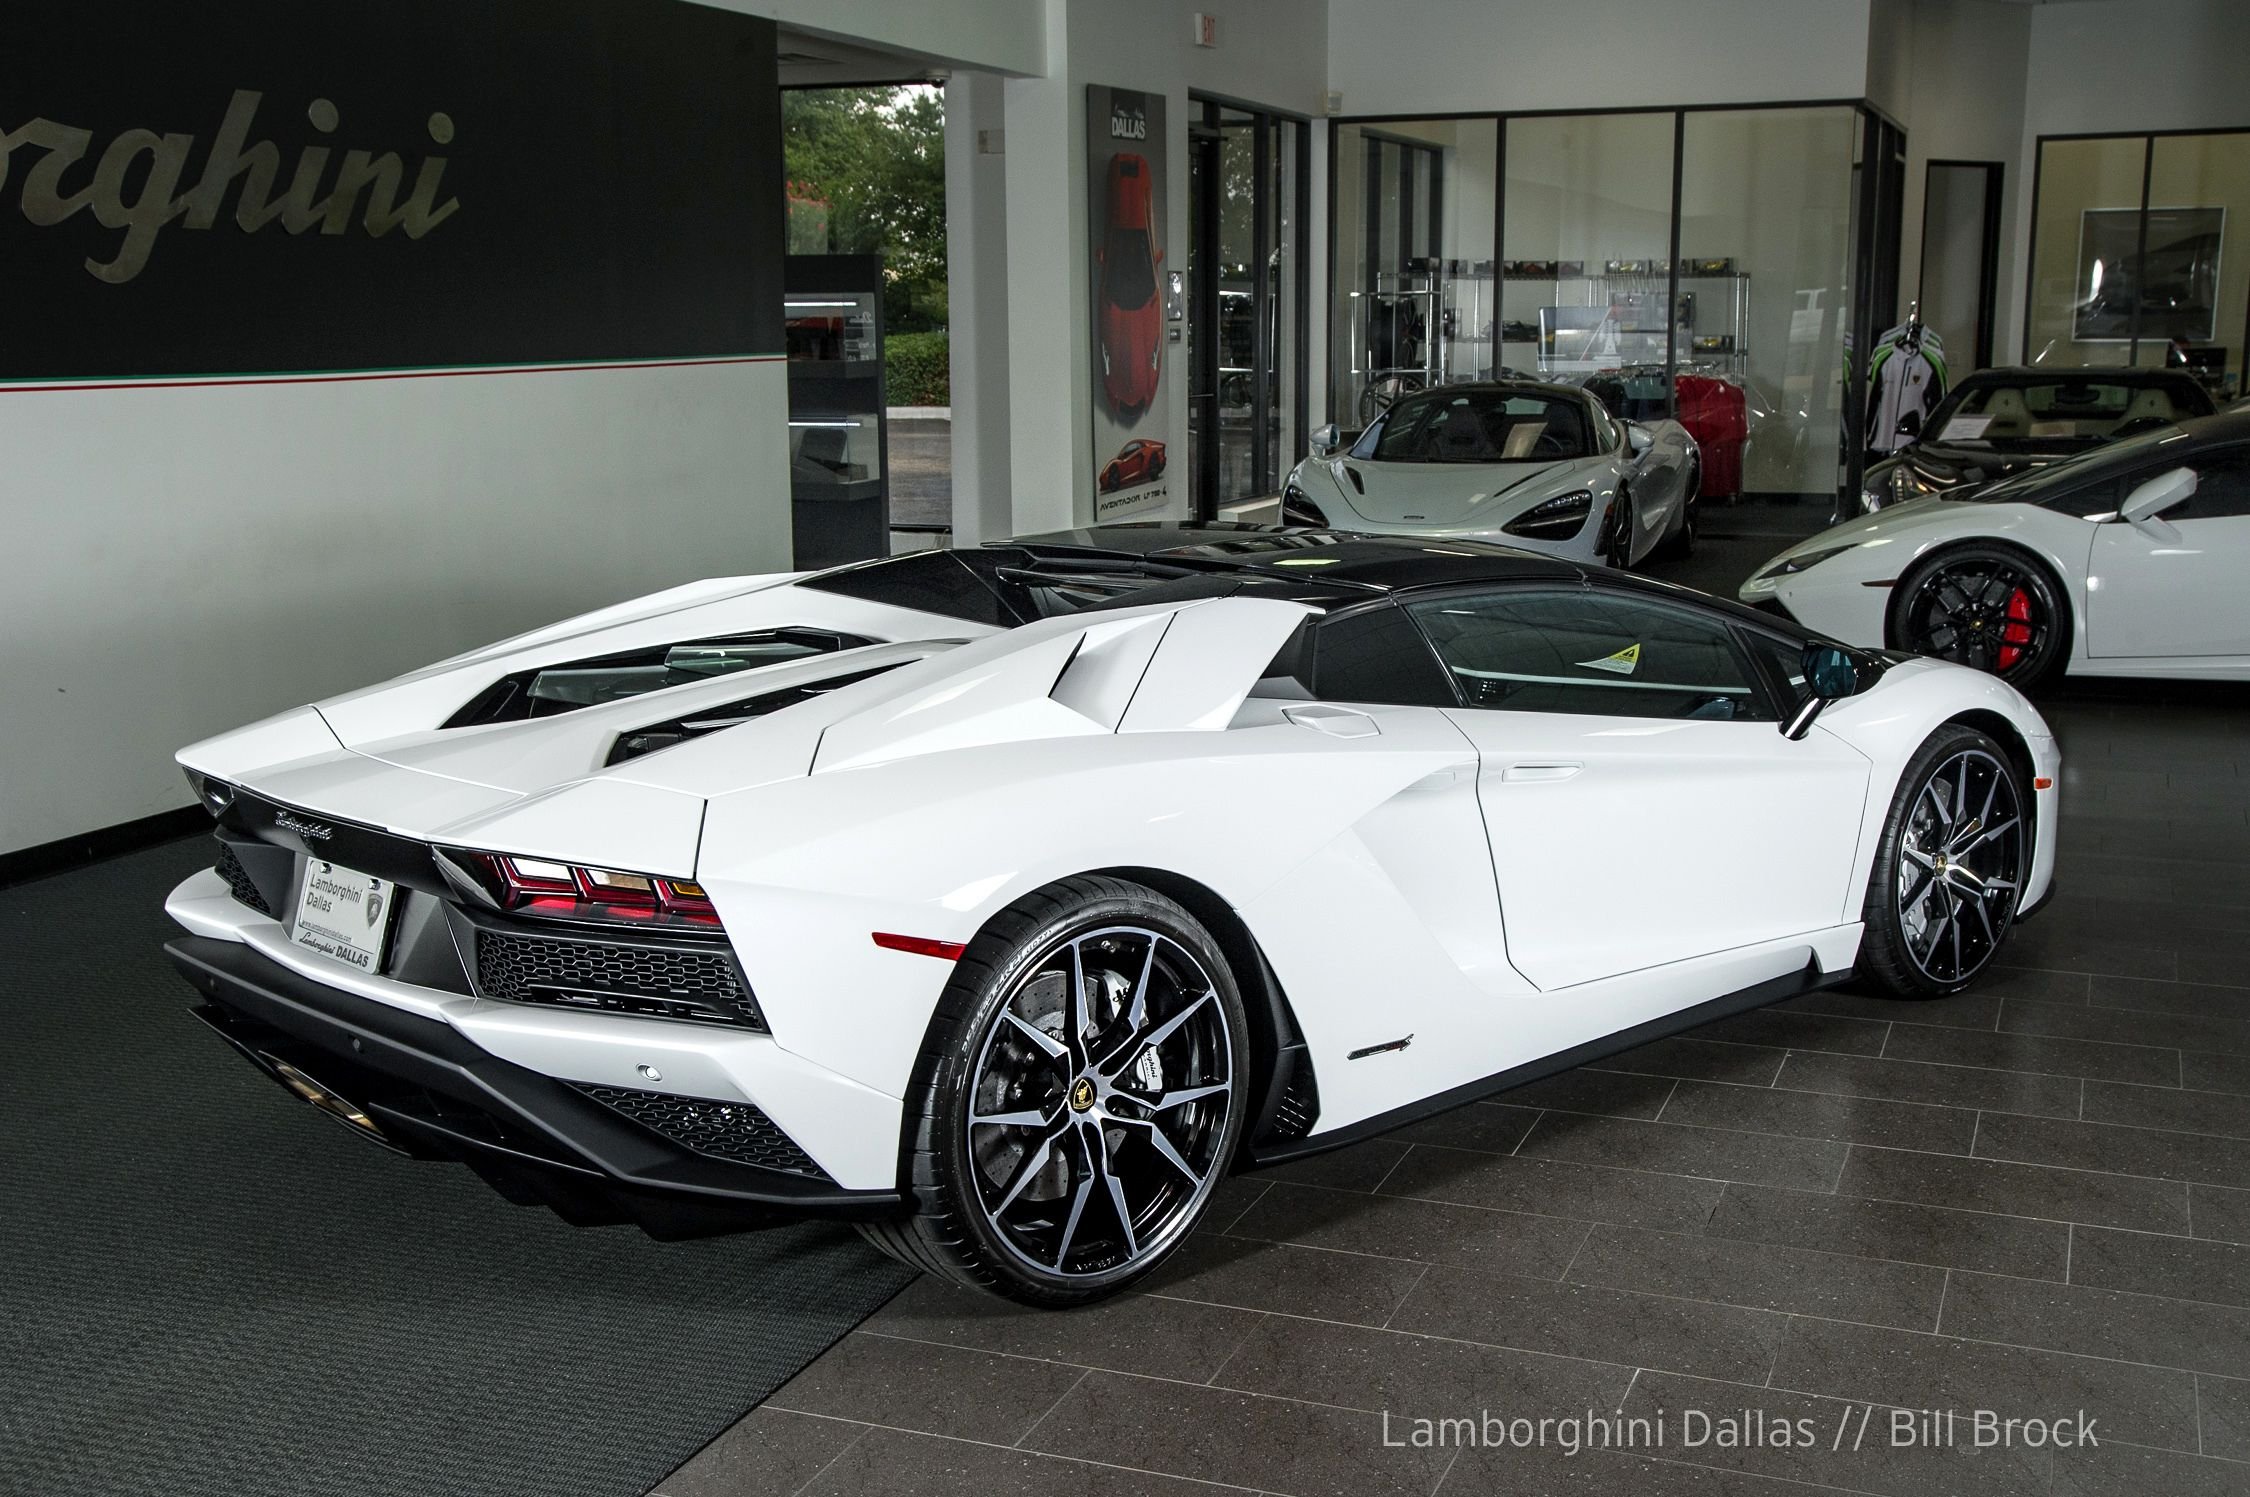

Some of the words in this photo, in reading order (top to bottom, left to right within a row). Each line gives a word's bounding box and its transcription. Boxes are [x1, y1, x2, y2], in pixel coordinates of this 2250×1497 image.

[1111, 116, 1146, 139] DALLAS
[0, 89, 460, 284] rghini
[306, 892, 333, 912] Dallas
[310, 874, 363, 903] Lamborghini
[299, 932, 336, 954] Lamborghini
[335, 945, 369, 968] DALLAS
